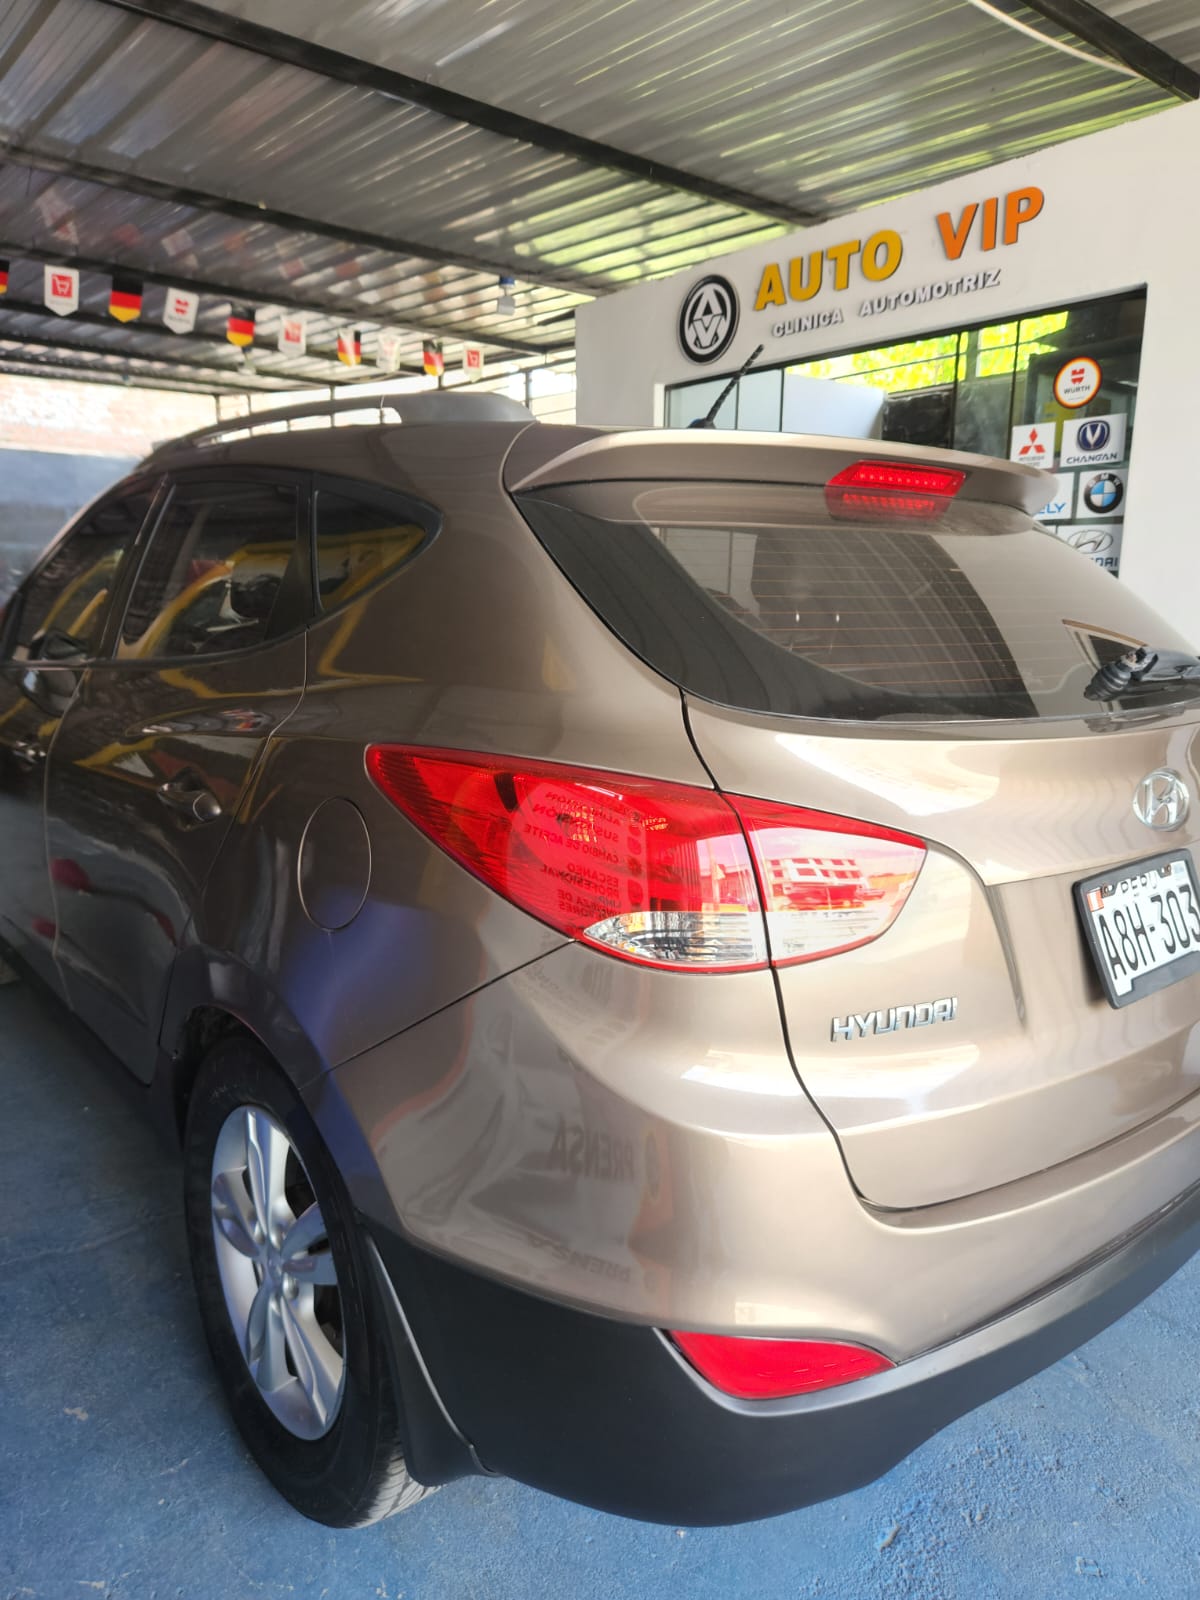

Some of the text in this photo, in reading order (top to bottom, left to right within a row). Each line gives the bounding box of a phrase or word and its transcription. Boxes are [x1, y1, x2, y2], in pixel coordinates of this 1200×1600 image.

[753, 186, 1045, 312] AUTO VIP
[771, 268, 1002, 338] CLINICA AUTOMOTRIZ
[1066, 452, 1119, 465] CHANGAN
[1098, 884, 1200, 980] A8H-303
[830, 997, 959, 1042] HYUNDAI
